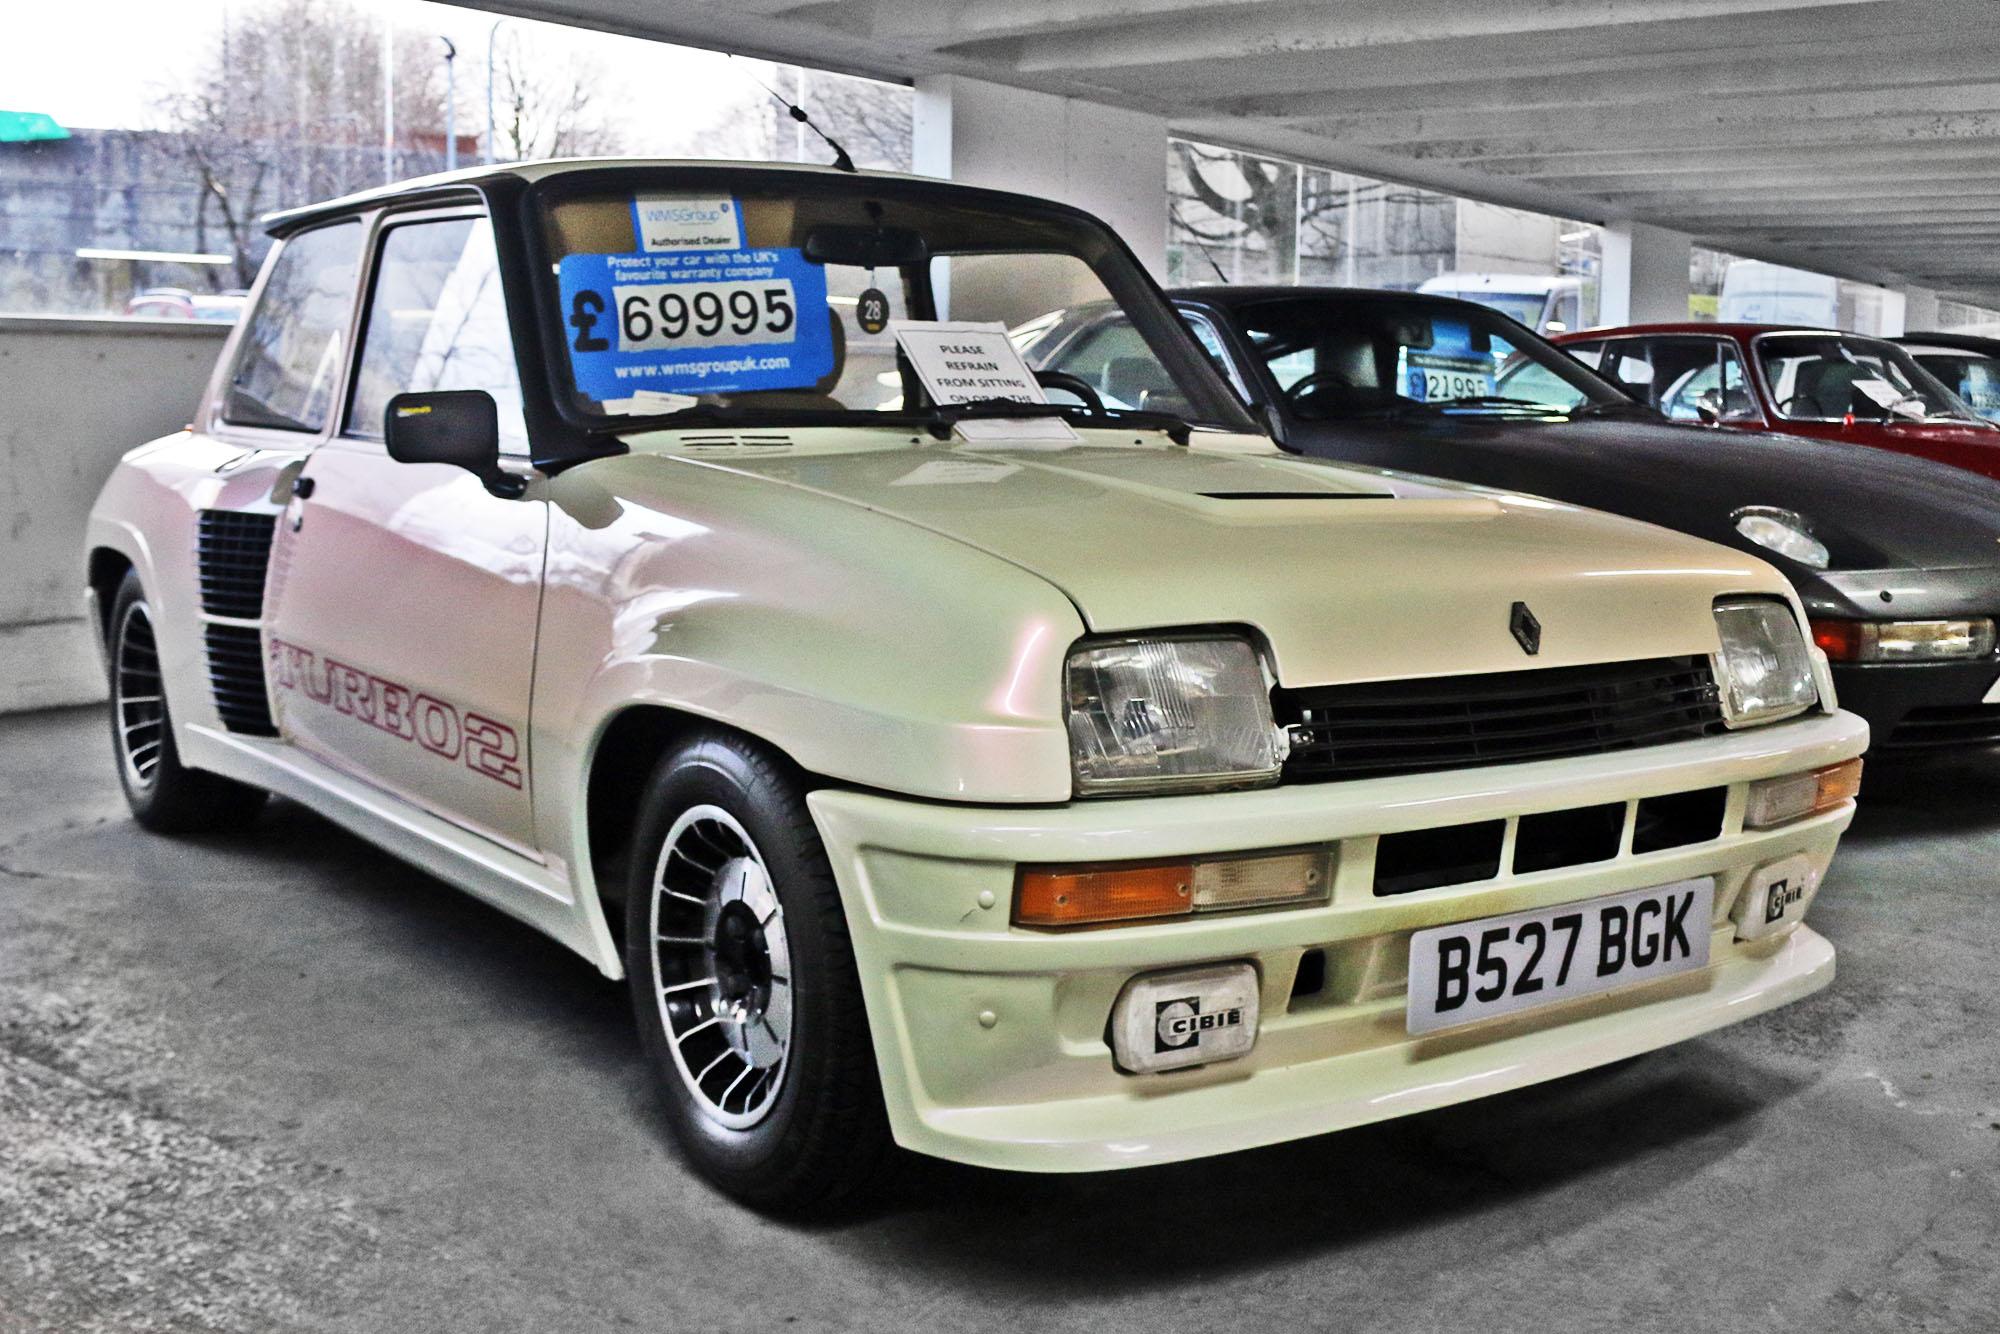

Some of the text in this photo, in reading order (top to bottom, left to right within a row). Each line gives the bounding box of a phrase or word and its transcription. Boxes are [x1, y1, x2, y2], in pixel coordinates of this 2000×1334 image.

[647, 208, 720, 223] WMSGroup
[651, 236, 732, 246] Authorised Dealer
[607, 256, 652, 268] Protect
[654, 257, 680, 269] your
[682, 256, 701, 265] car
[704, 252, 731, 264] with
[733, 252, 751, 264] the
[615, 266, 774, 282] favourite warranty company
[623, 289, 794, 342] 69995
[865, 300, 881, 320] 28
[940, 345, 985, 355] PLEASE
[614, 356, 791, 379] www.wmsgroupuk.com
[945, 361, 999, 371] REFRAIN
[937, 378, 1026, 388] FROM SITTING
[1435, 891, 1695, 1014] B527 BGK
